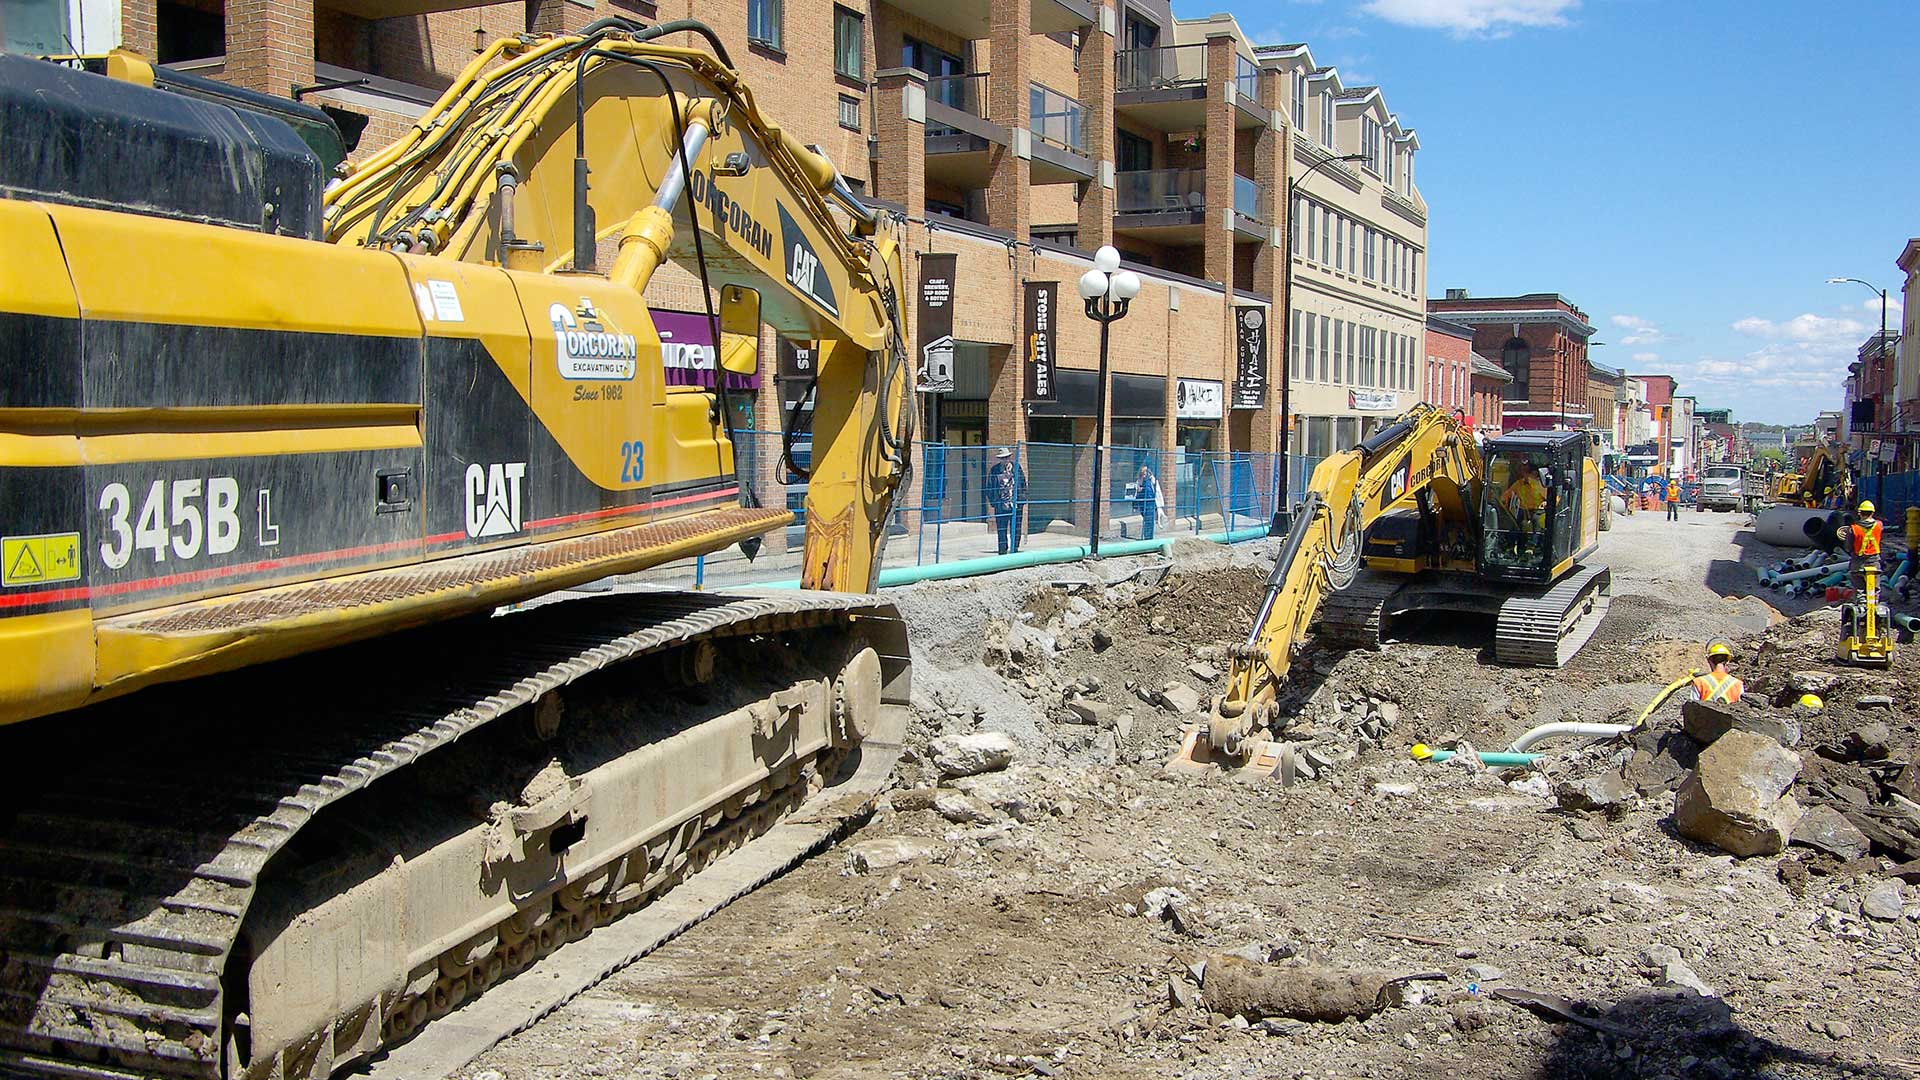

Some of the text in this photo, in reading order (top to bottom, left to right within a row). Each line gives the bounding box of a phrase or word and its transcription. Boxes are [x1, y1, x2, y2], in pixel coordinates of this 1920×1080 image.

[690, 168, 773, 261] ORCORAN
[792, 242, 818, 297] CAT
[549, 302, 637, 359] CORCORAN
[1036, 289, 1048, 396] STONE CITY ALES
[573, 363, 614, 373] EXCAVATING
[573, 384, 623, 401] Since 1962
[620, 440, 644, 483] 23
[1390, 466, 1406, 500] CAT
[1410, 458, 1441, 488] CORCOR
[98, 476, 280, 570] 345B L
[464, 462, 527, 539] CAT
